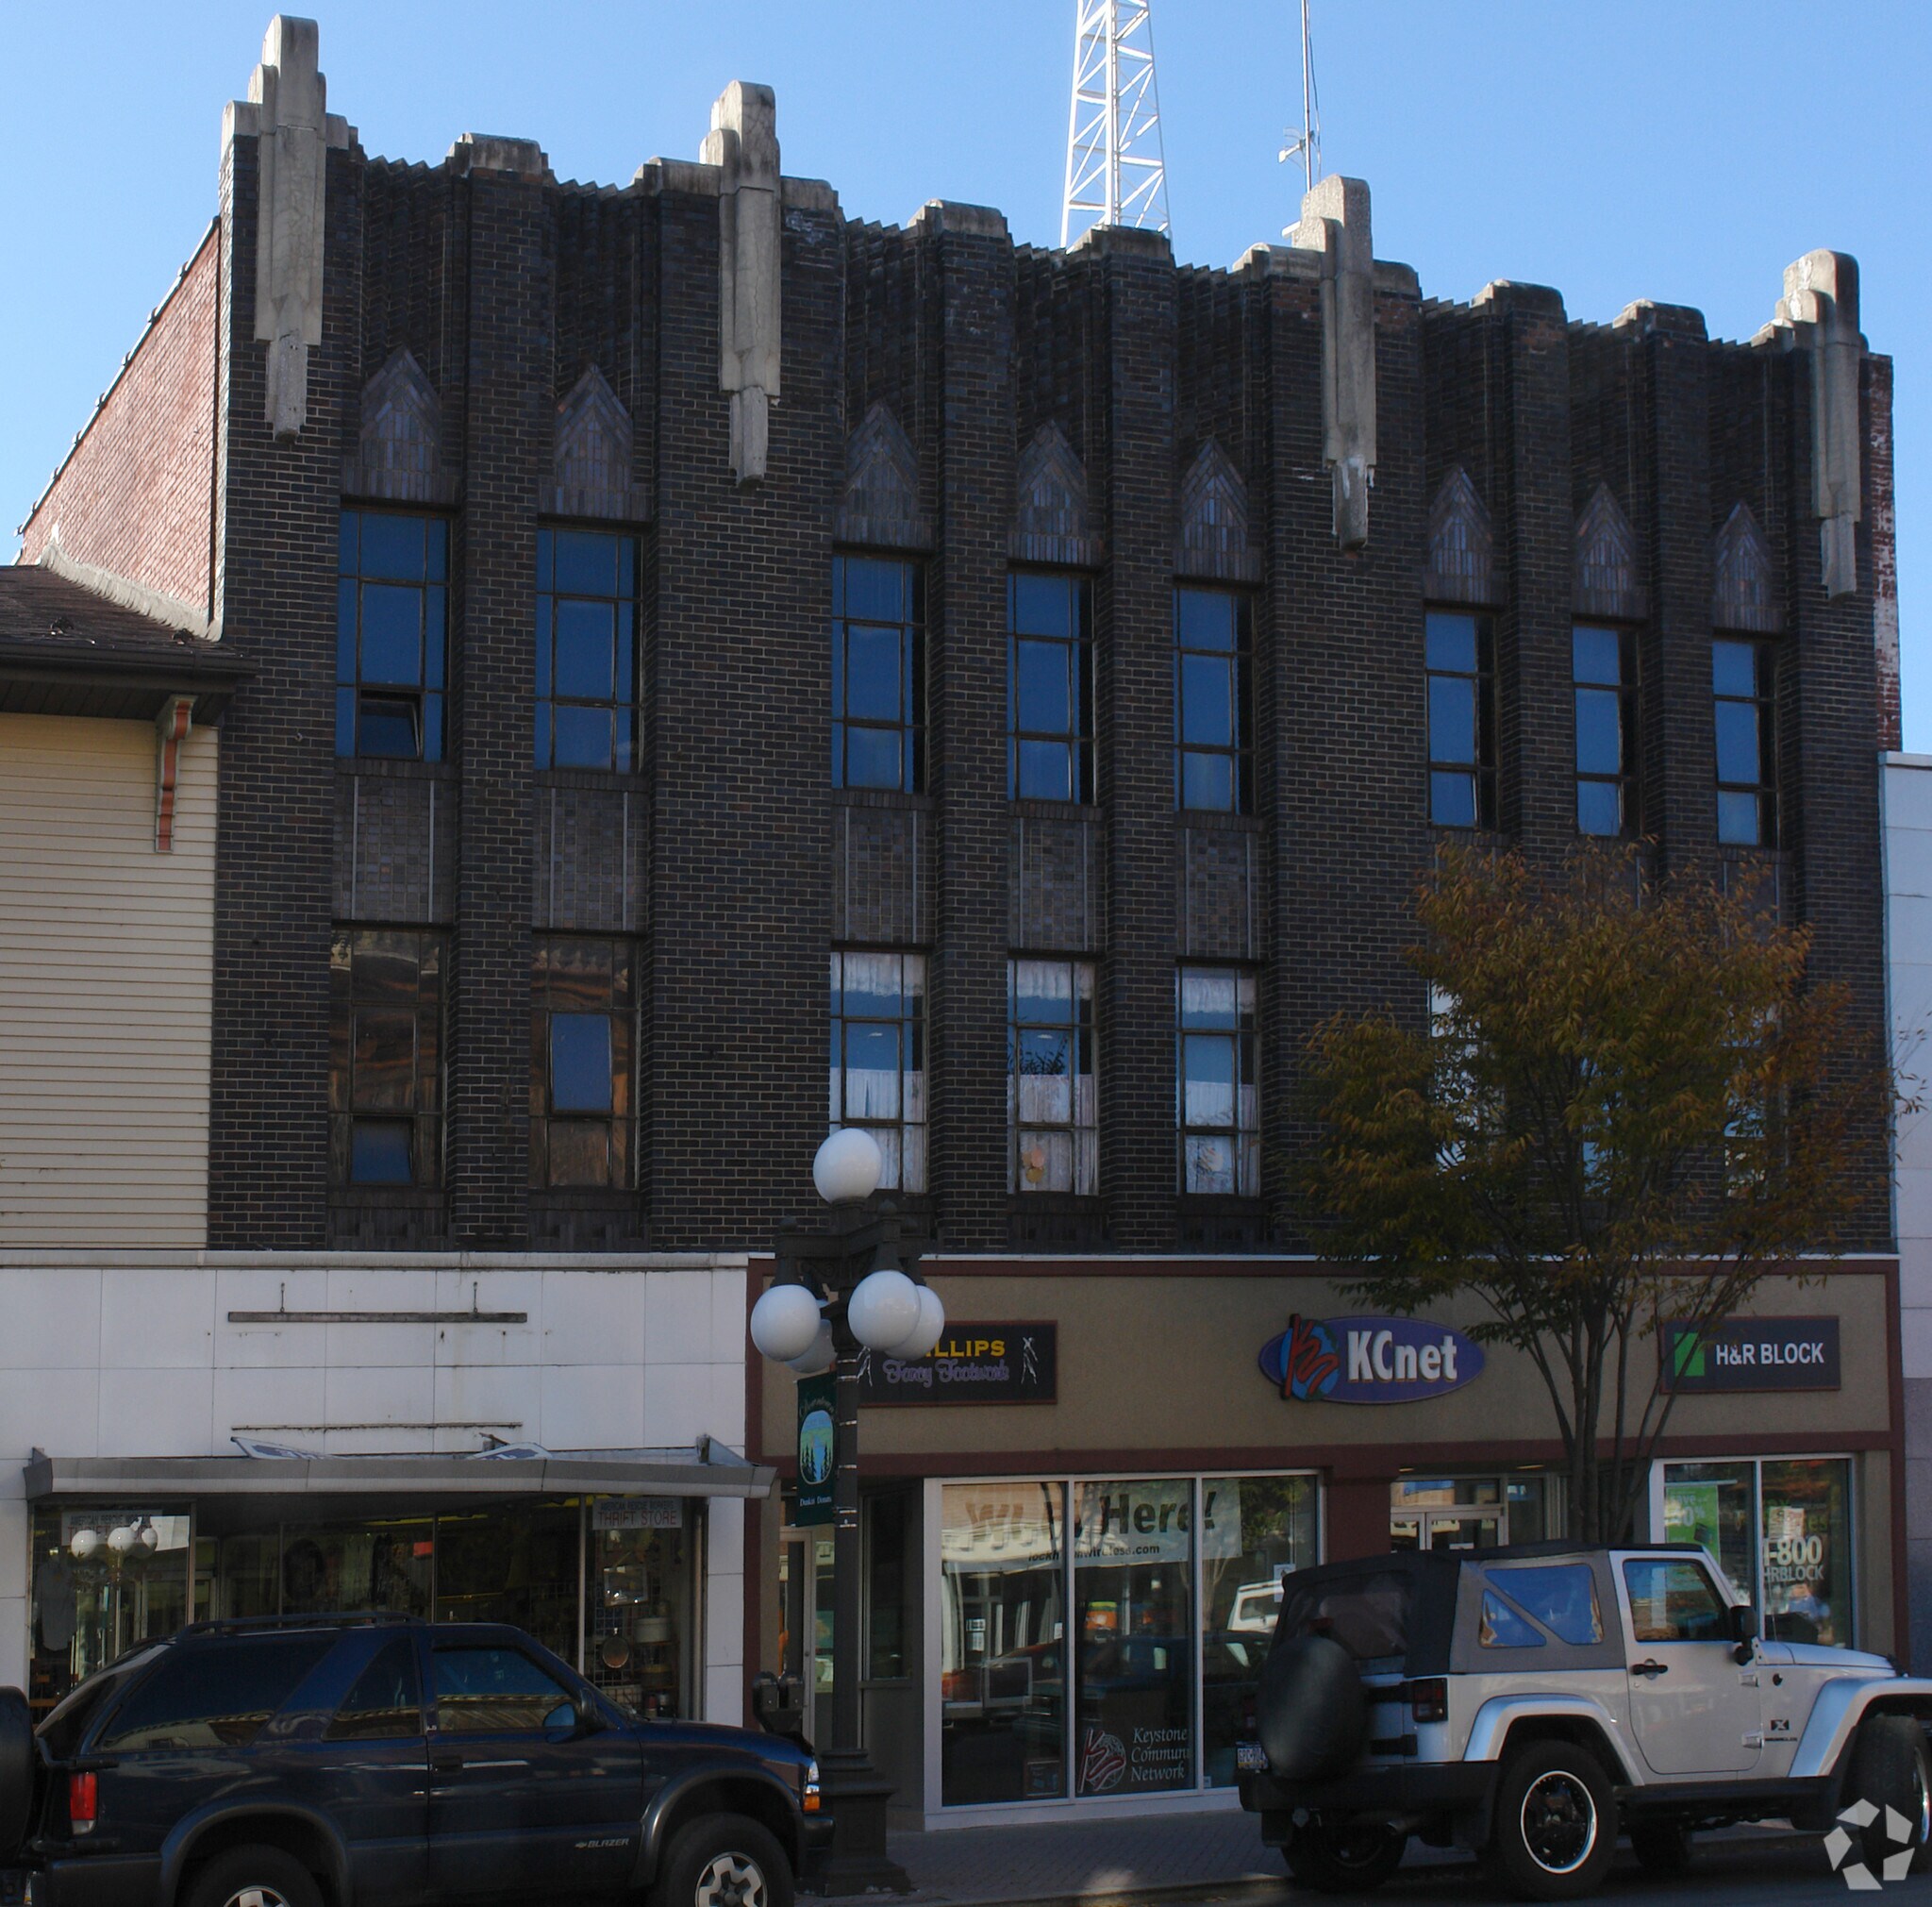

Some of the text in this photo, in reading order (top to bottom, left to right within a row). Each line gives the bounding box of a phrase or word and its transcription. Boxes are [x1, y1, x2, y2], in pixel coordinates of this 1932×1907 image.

[1347, 1330, 1458, 1383] KCnet
[1716, 1342, 1825, 1365] H&R BLOCK
[882, 1359, 1009, 1388] Fancy Footwork
[597, 1510, 677, 1526] THRIFT STORE
[1763, 1535, 1823, 1567] 1-800
[1133, 1728, 1188, 1749] Keystone
[1131, 1761, 1186, 1782] Network
[588, 1838, 630, 1848] BLAZER
